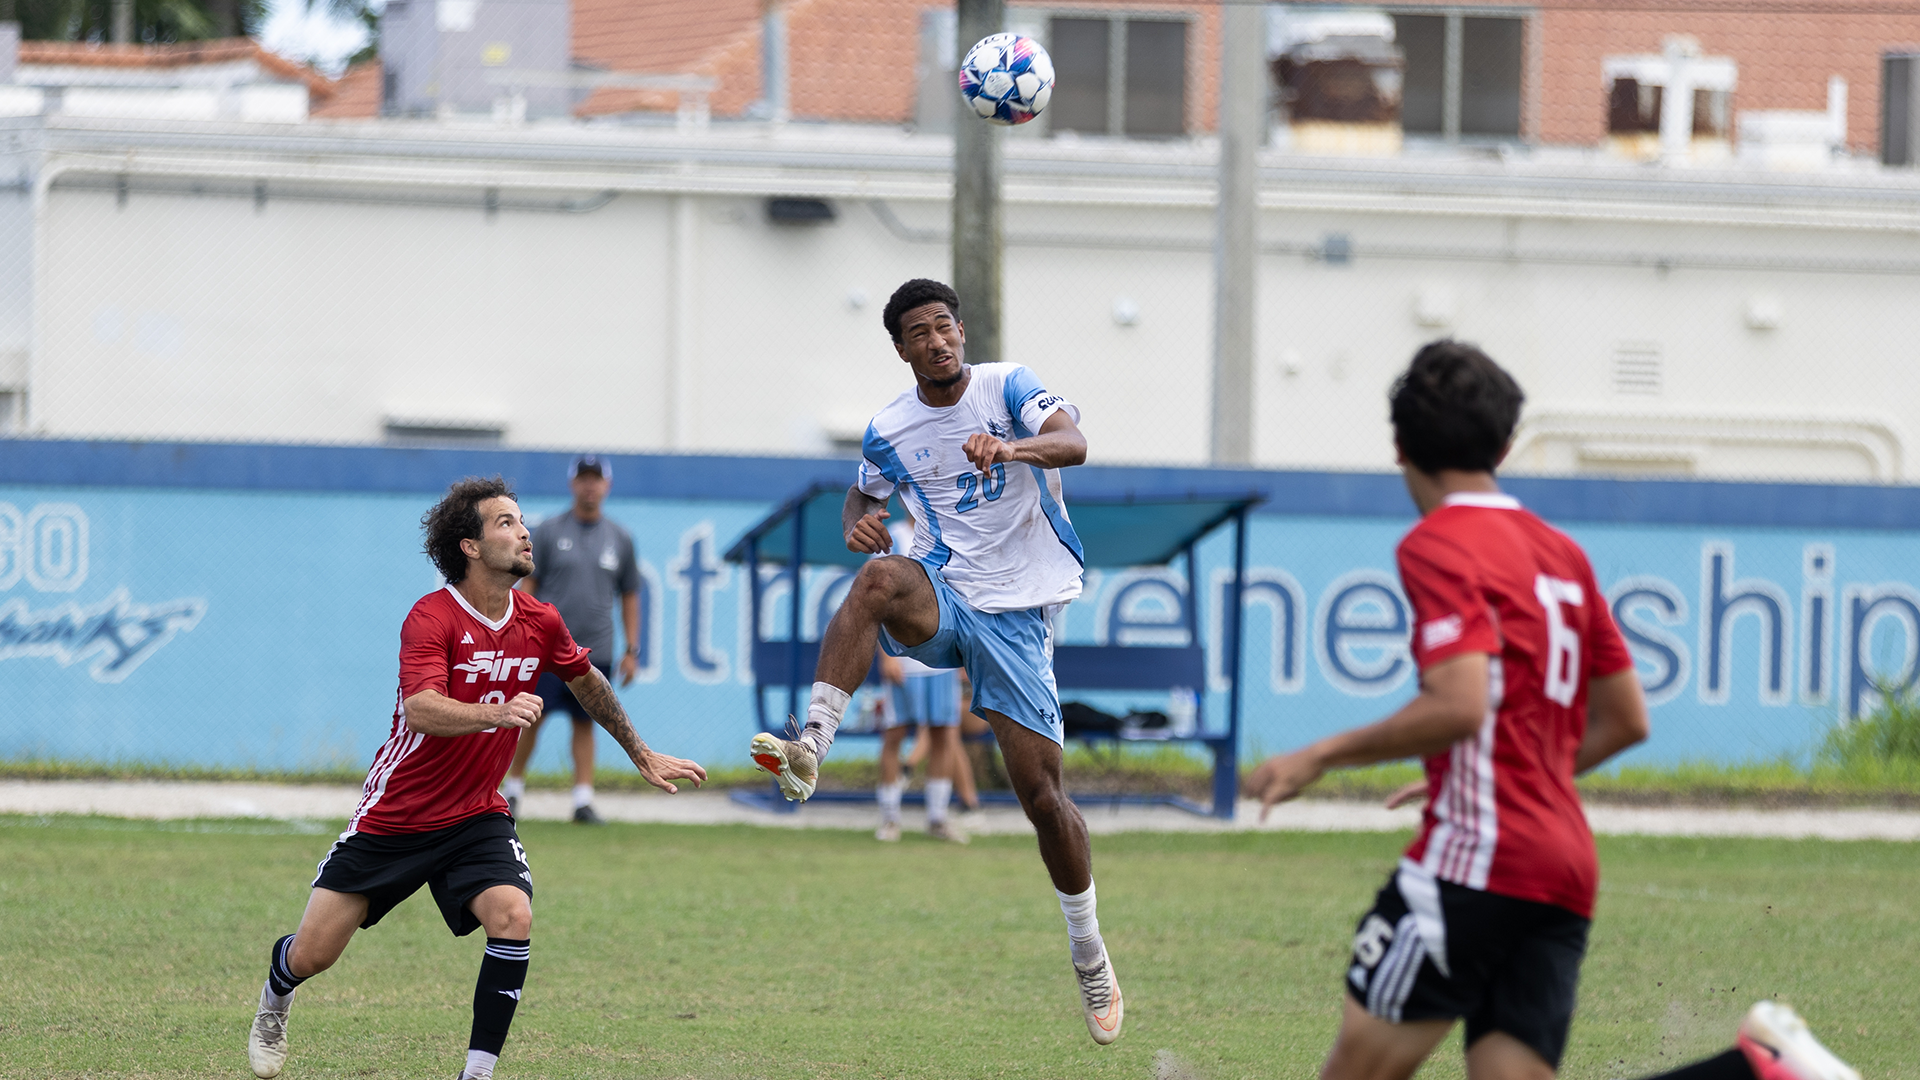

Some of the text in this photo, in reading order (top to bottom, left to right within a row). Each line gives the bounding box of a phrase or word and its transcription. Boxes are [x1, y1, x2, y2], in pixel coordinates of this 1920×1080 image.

[955, 462, 1006, 514] 20
[1533, 572, 1584, 708] 6
[453, 650, 540, 683] Fire
